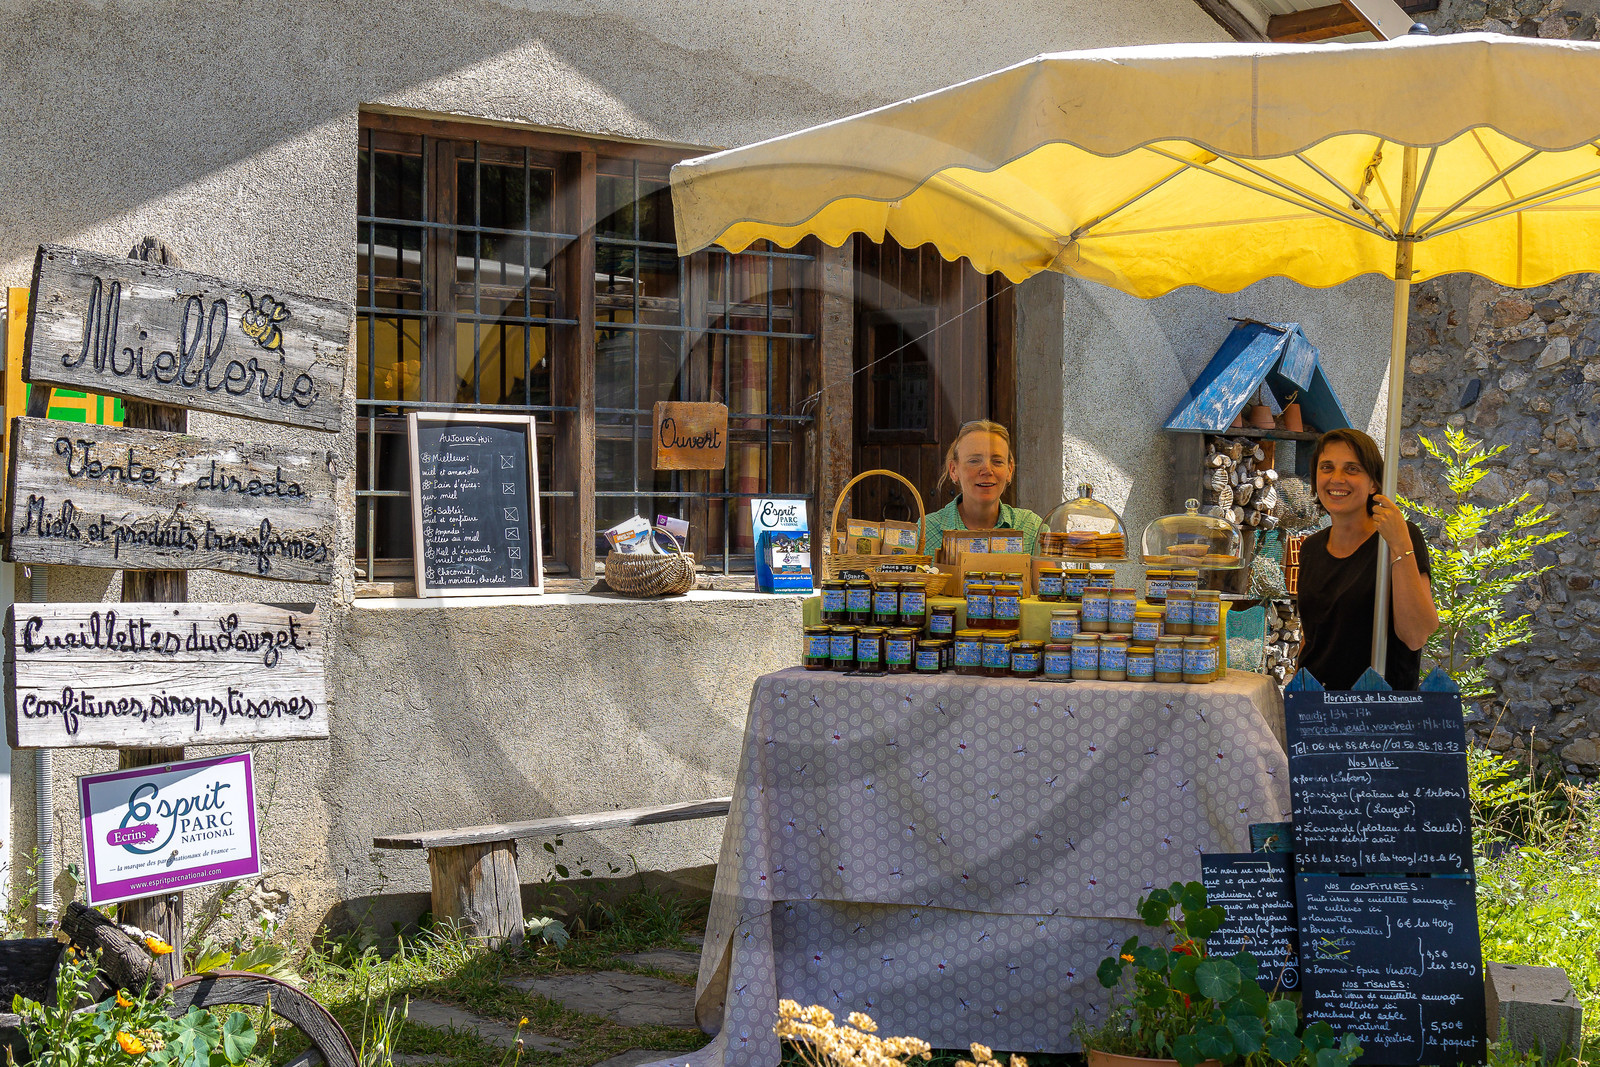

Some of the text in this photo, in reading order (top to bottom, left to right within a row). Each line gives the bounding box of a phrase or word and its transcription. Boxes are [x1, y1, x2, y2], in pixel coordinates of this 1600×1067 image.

[62, 276, 320, 408] Miellerie
[660, 418, 722, 449] Ouvert
[54, 436, 161, 484] Vente
[440, 490, 458, 500] miel
[20, 494, 80, 541] Miels
[88, 514, 113, 541] et
[112, 520, 198, 560] produits
[464, 531, 480, 542] miel
[435, 556, 455, 564] miel
[22, 611, 181, 656] Cueillettes
[227, 687, 314, 720] tisanes
[1323, 692, 1361, 702] Horaires
[1365, 693, 1374, 702] de
[1377, 692, 1386, 702] la
[1348, 754, 1367, 768] Nos
[1397, 790, 1409, 798] de
[118, 781, 231, 854] Esprit
[180, 811, 233, 833] PARC
[1403, 824, 1416, 832] de
[114, 829, 147, 844] Ecrins
[181, 828, 235, 844] NATIONAL
[123, 862, 146, 871] marque
[202, 849, 210, 857] de
[210, 847, 229, 857] France
[130, 868, 222, 890] www.espritparcnational.com
[1204, 879, 1220, 888] que
[1238, 879, 1257, 889] que
[1261, 900, 1293, 914] produits
[1353, 896, 1364, 904] de
[1368, 894, 1408, 904] cueillette
[1413, 897, 1456, 910] sauvage
[1238, 915, 1253, 926] pas
[1432, 918, 1454, 934] 400g
[1421, 993, 1464, 1005] sauvage
[1360, 1011, 1372, 1020] de
[1426, 1035, 1438, 1045] le
